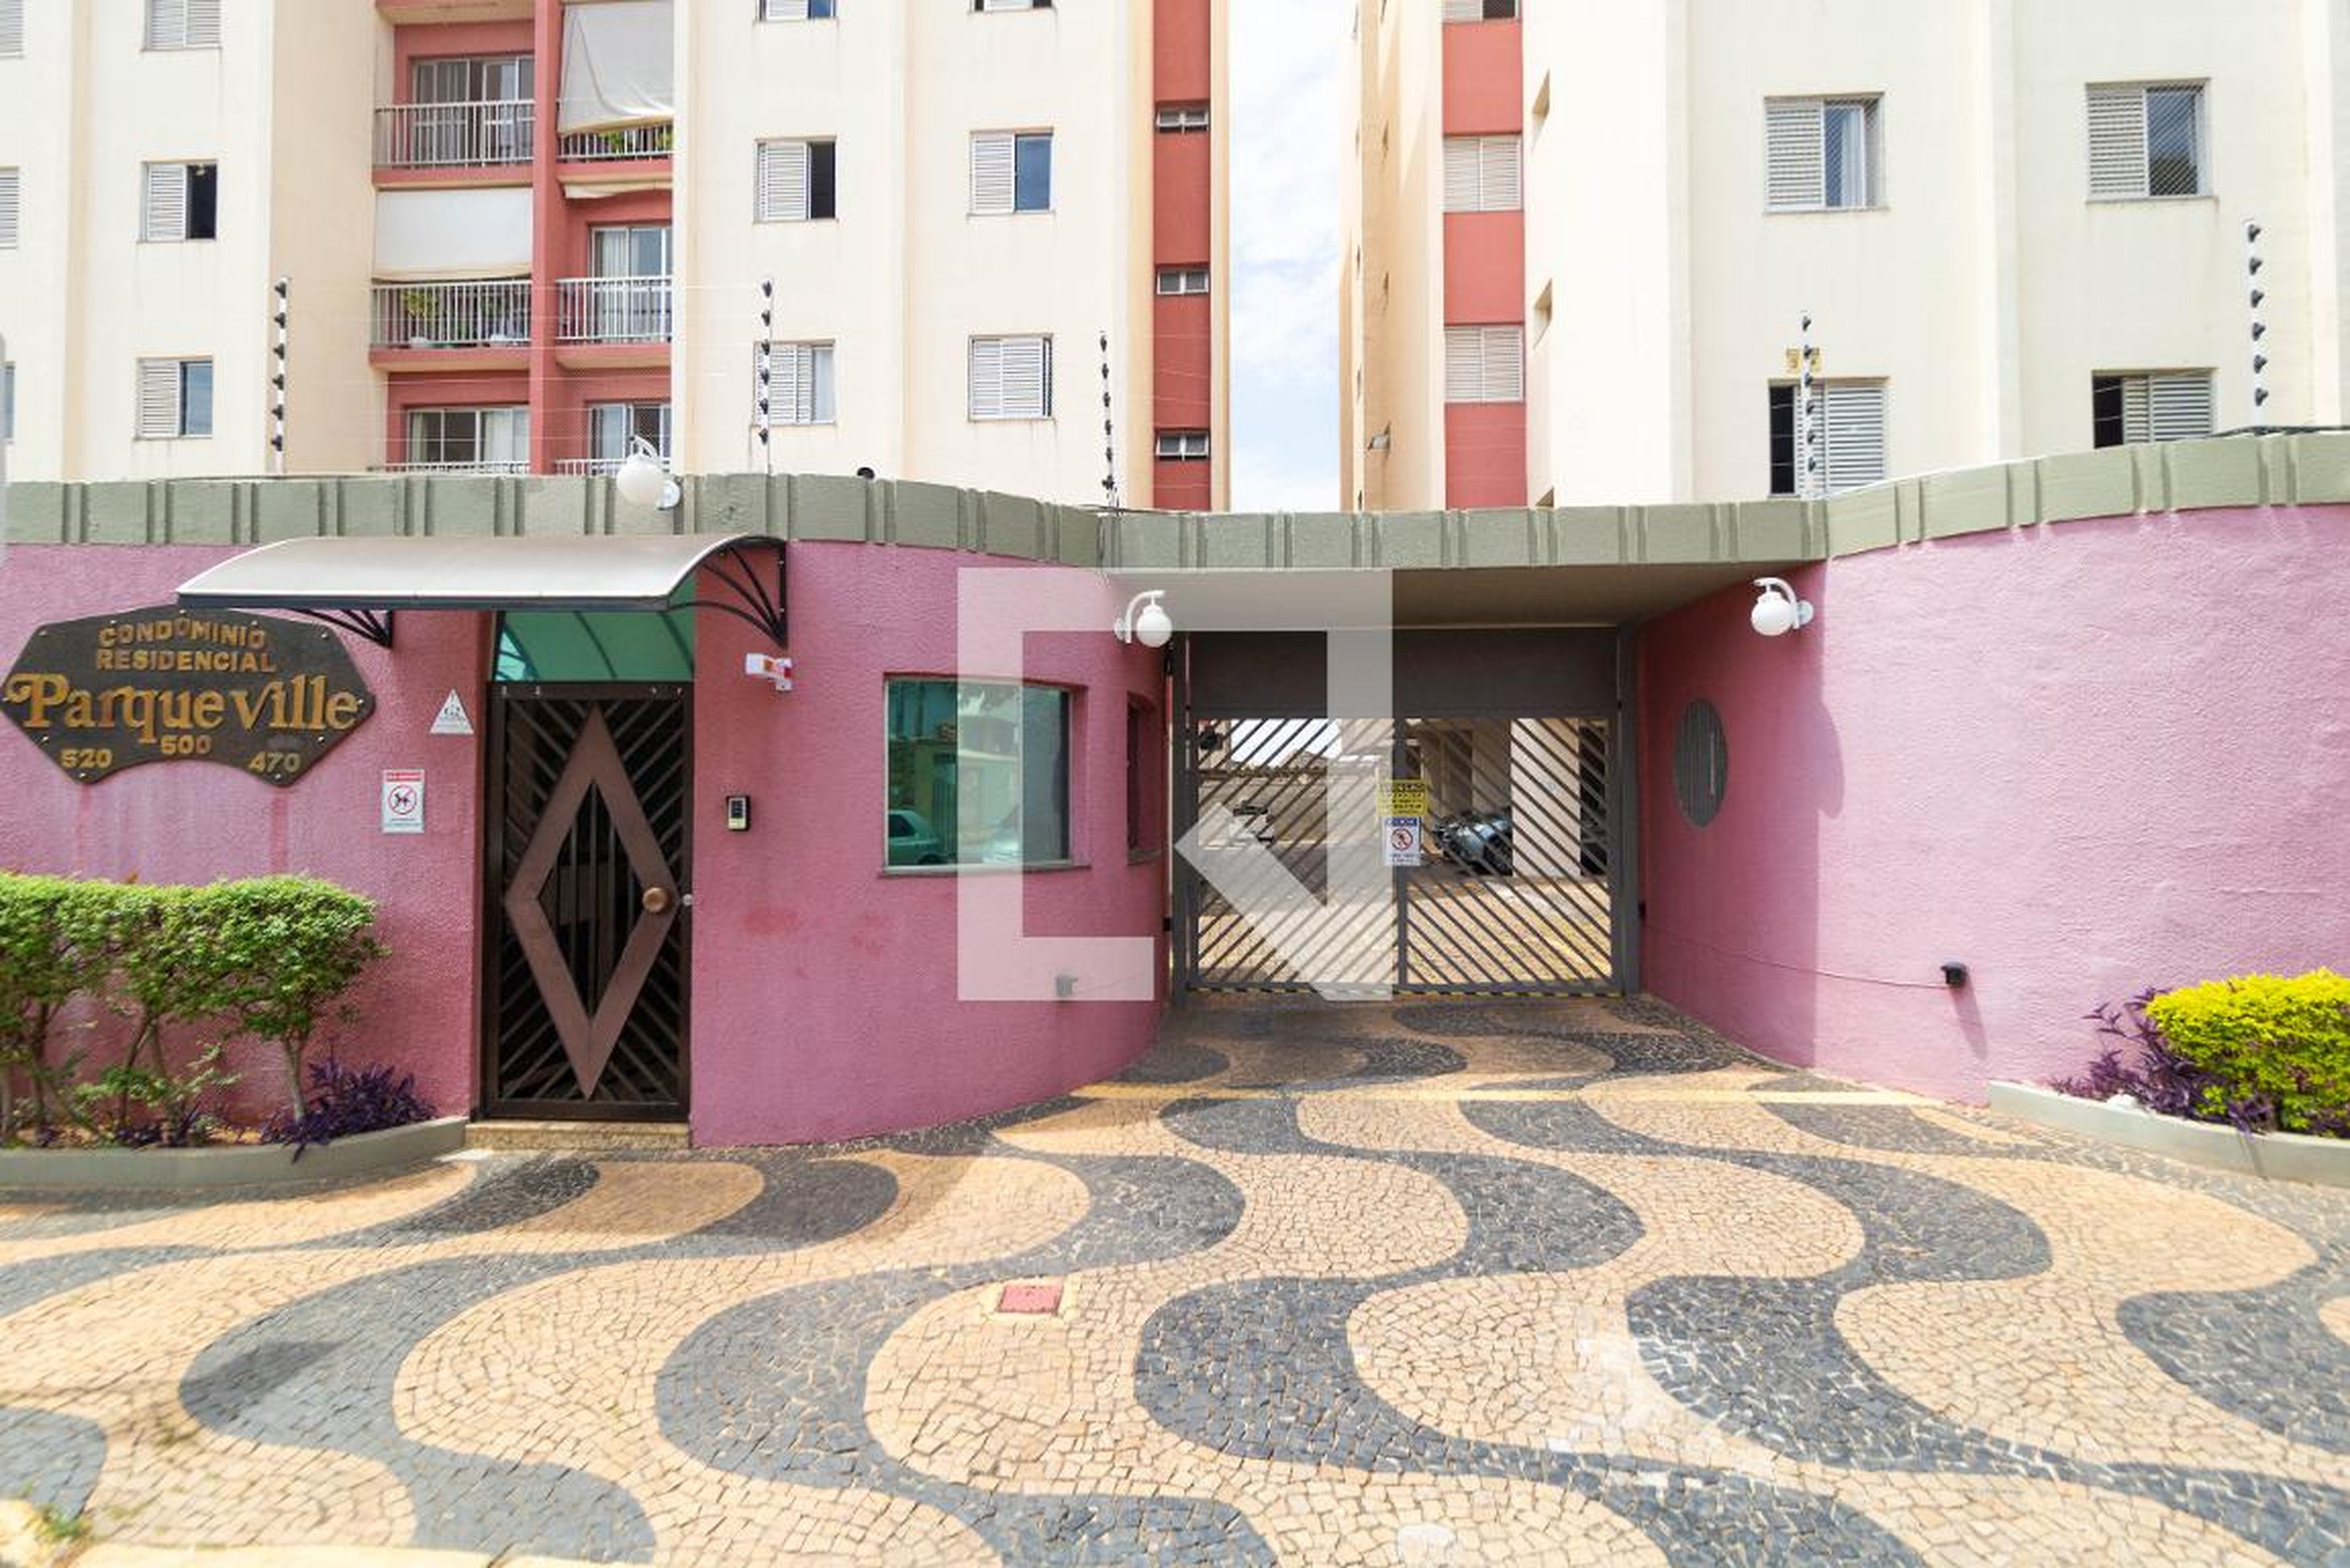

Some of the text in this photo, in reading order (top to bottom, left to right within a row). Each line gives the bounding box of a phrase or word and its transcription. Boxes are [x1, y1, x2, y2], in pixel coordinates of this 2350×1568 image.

[98, 618, 267, 649] CONDOMINIO
[97, 649, 275, 672] RESIDENCIAL
[4, 673, 225, 744] Parque
[62, 749, 113, 769] 520
[248, 750, 300, 772] 470
